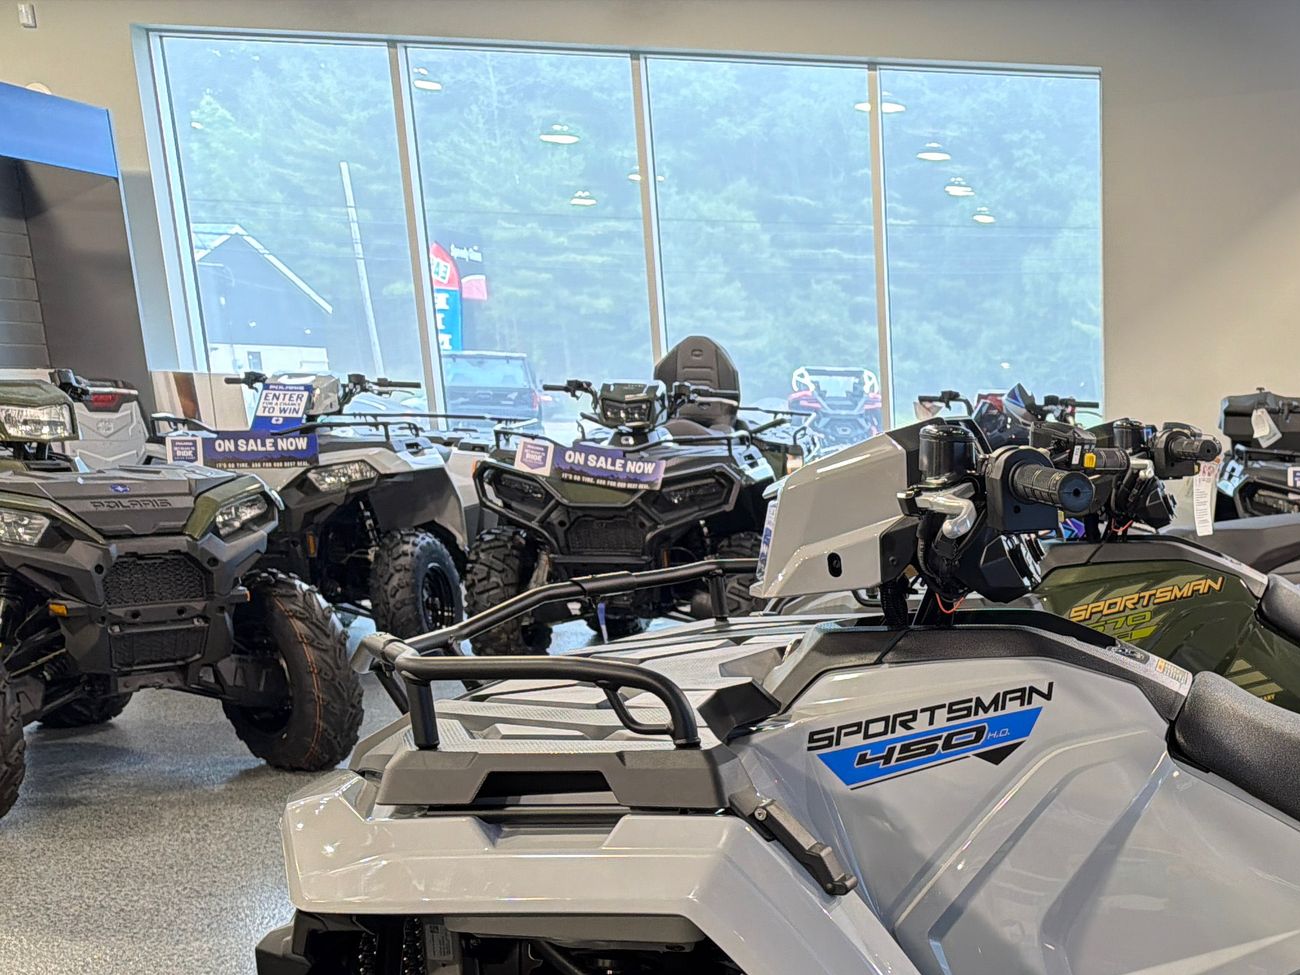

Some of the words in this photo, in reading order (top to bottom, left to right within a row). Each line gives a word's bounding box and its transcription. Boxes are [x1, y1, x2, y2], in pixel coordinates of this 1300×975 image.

[264, 392, 304, 402] ENTER
[262, 406, 275, 414] TO
[278, 407, 300, 415] WIN
[214, 438, 235, 452] ON
[237, 438, 275, 451] SALE
[277, 437, 307, 451] NOW
[564, 450, 586, 466] ON
[587, 454, 624, 472] SALE
[626, 460, 656, 474] NOW
[90, 498, 172, 508] POLARIS
[1069, 576, 1225, 623] SPORTSMAN
[807, 681, 1054, 752] SPORTSMAN
[855, 723, 988, 769] 450
[987, 729, 1011, 740] H.O.
